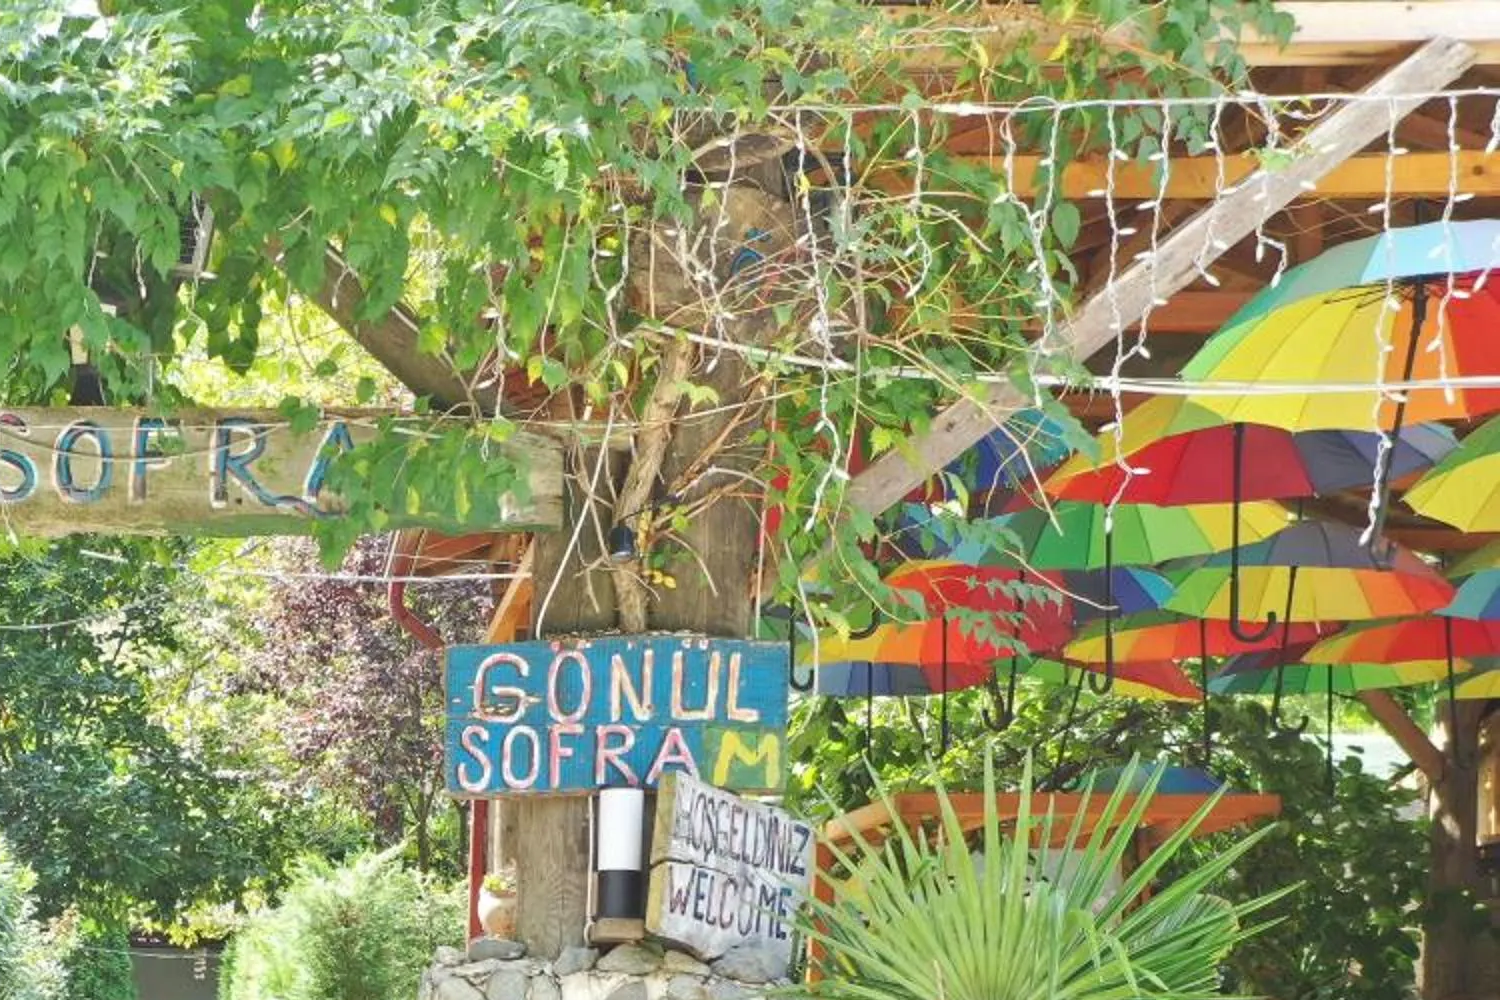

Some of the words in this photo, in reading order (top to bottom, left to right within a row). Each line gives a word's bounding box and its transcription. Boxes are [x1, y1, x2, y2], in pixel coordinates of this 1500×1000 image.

[473, 638, 761, 724] GÖNÜL
[456, 724, 781, 793] SOFRAM
[668, 864, 793, 941] WELCOME
